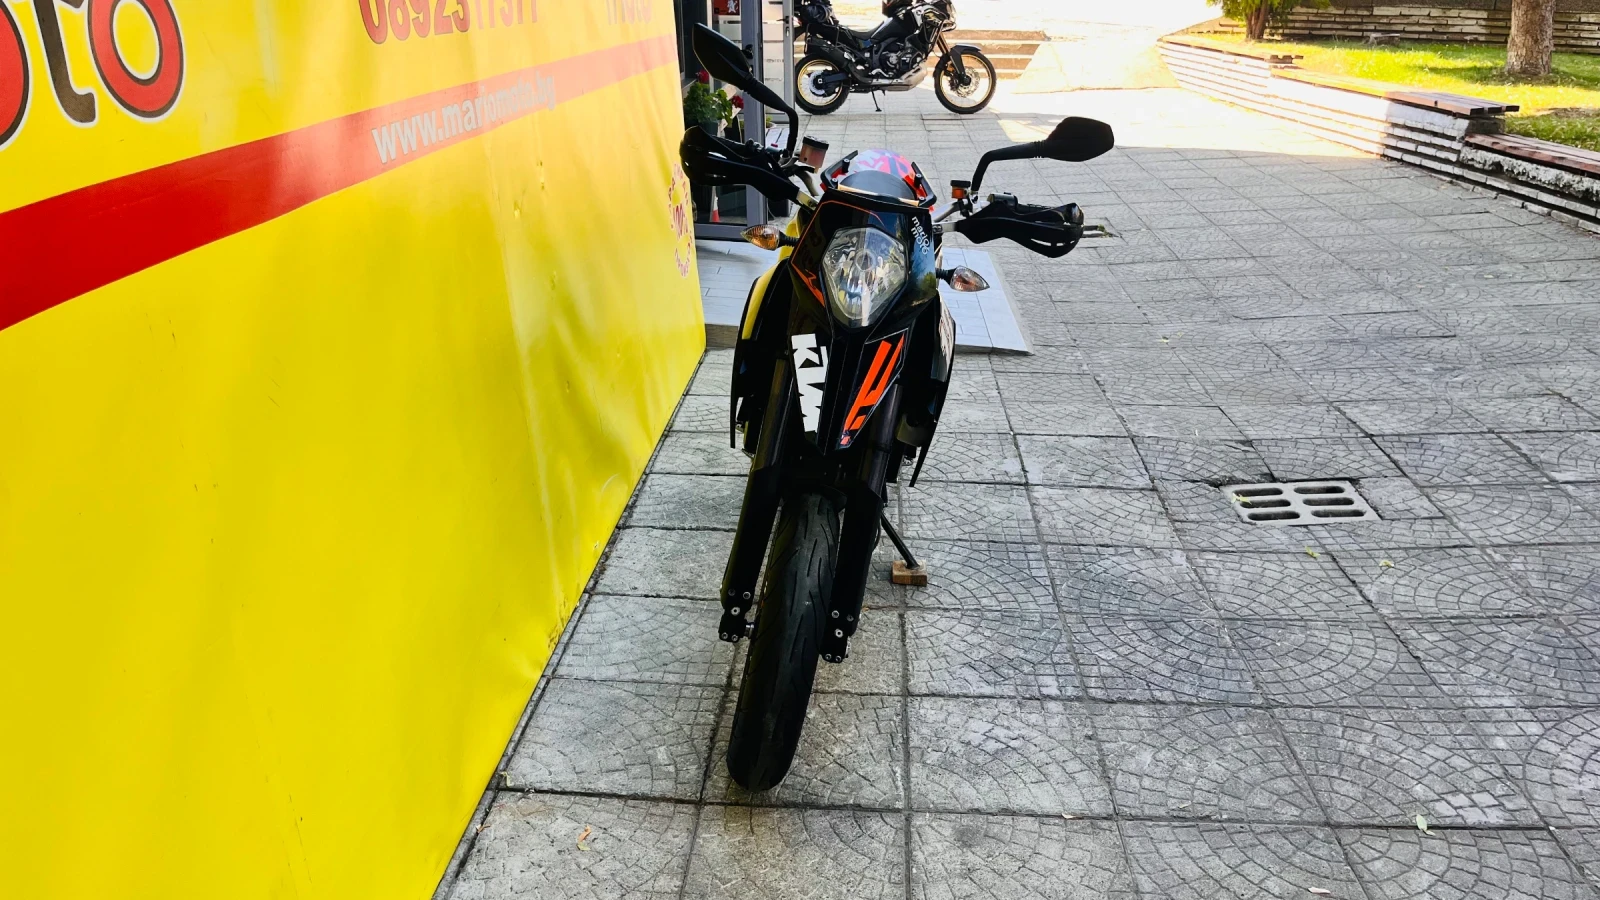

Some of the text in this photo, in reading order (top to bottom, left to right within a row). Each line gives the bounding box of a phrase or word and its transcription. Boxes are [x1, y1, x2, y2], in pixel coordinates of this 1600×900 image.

[372, 70, 556, 164] www.mariomoto.bg
[910, 227, 929, 255] moto
[911, 216, 930, 246] mario
